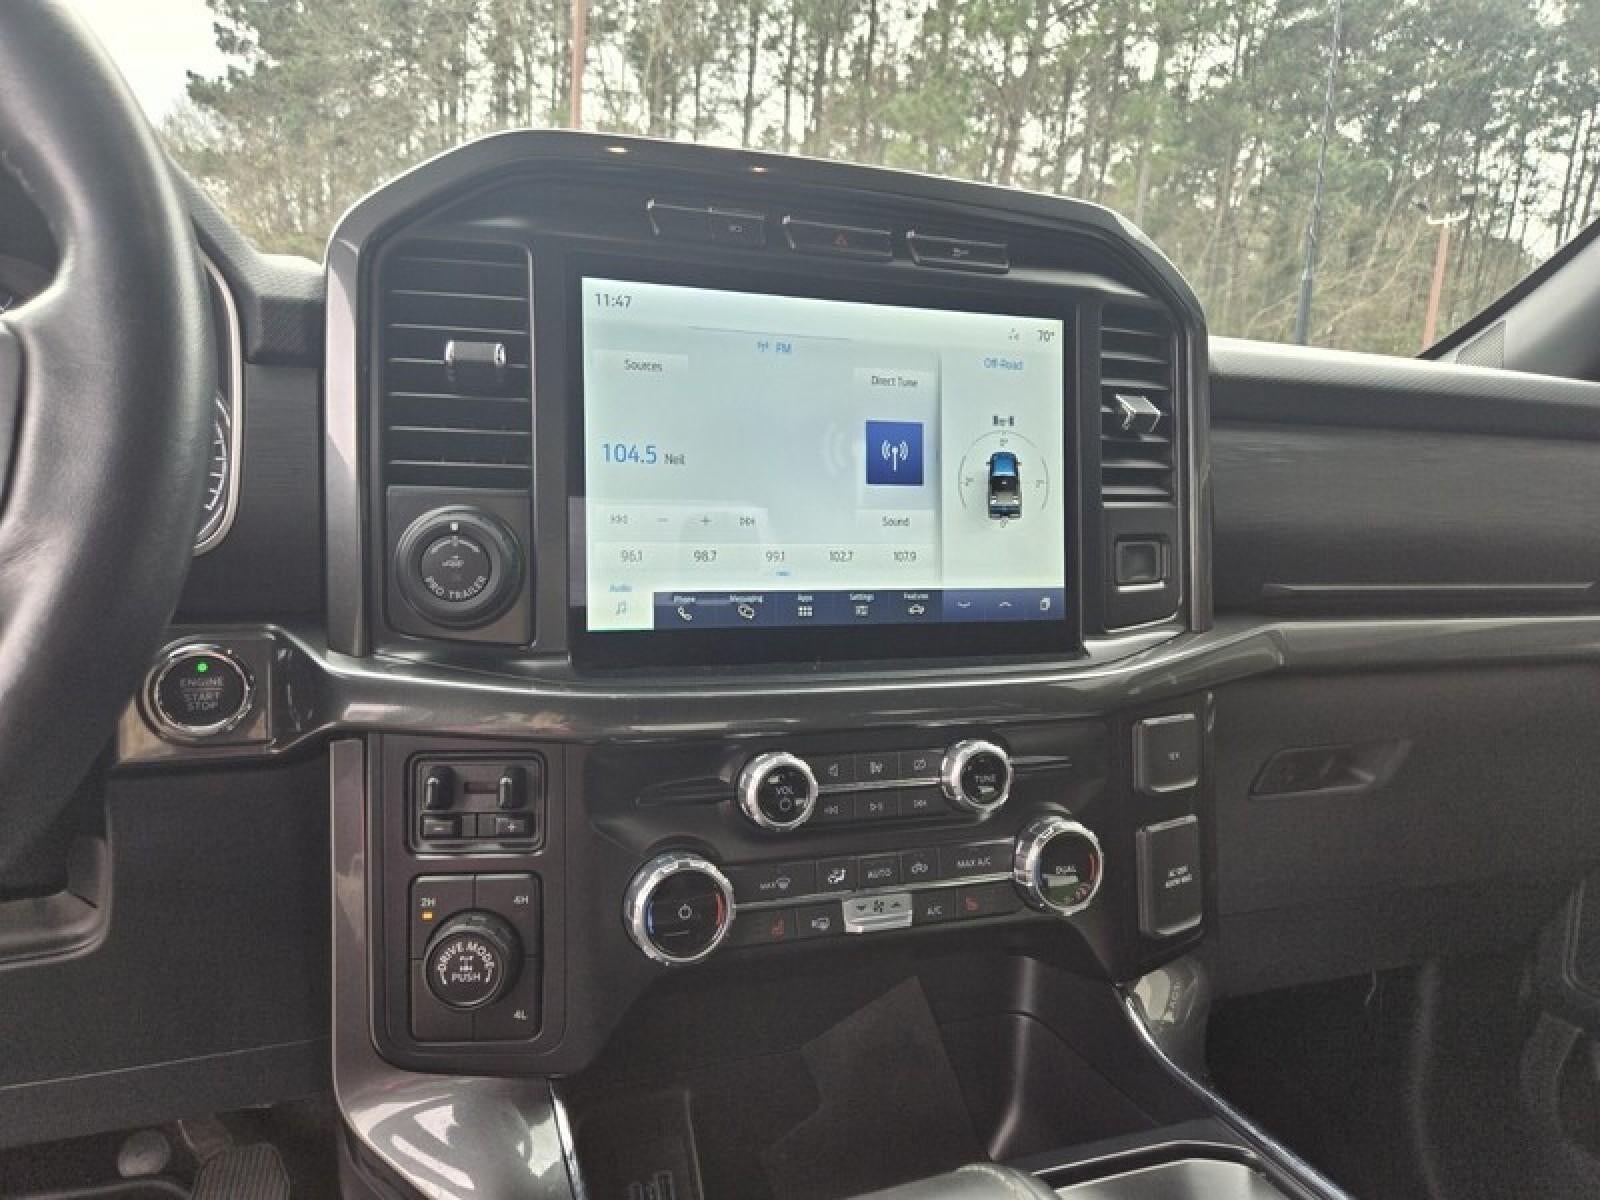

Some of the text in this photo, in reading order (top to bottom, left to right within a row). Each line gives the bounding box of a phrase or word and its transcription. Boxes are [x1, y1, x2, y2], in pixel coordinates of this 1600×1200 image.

[594, 292, 632, 309] 11:47
[775, 342, 793, 354] FM
[623, 358, 663, 372] Sources
[983, 357, 1024, 371] Off-Road
[871, 375, 919, 388] Direct Tune
[601, 442, 658, 465] 104.5
[881, 515, 911, 528] Sound
[775, 785, 794, 796] VOL
[450, 971, 481, 983] PUSH
